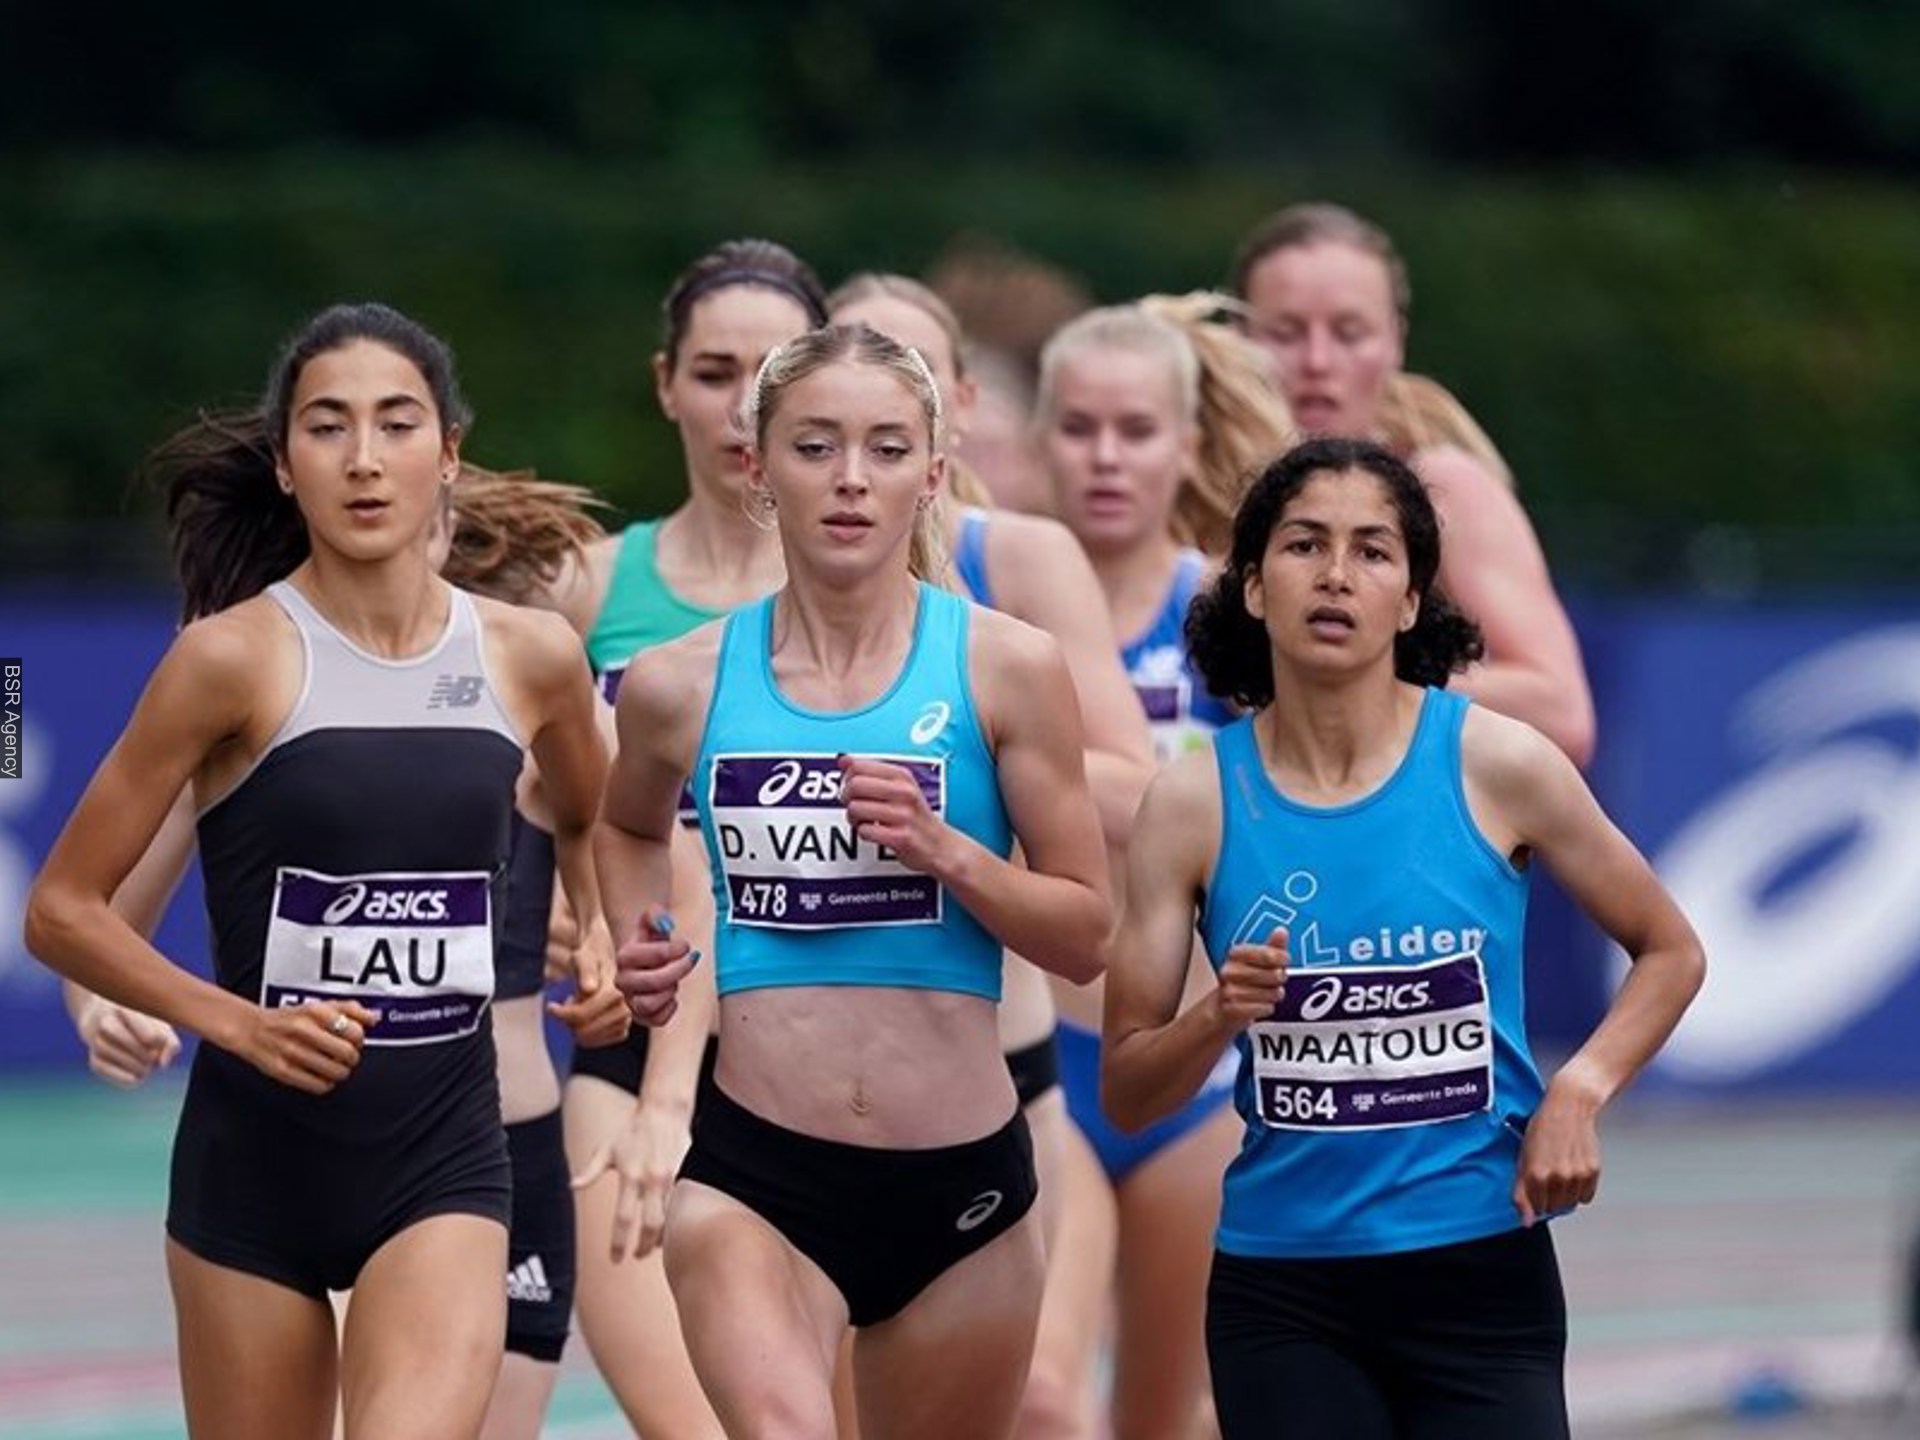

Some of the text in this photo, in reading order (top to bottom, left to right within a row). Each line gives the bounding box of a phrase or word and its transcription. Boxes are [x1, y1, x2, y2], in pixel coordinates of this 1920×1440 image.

[718, 824, 757, 860] D.
[766, 824, 858, 862] VAN
[363, 890, 449, 920] asics
[740, 883, 788, 918] 478
[319, 936, 447, 987] LAU
[1342, 980, 1431, 1013] asics
[1258, 1019, 1485, 1065] MAATOUG
[1274, 1086, 1338, 1120] 564
